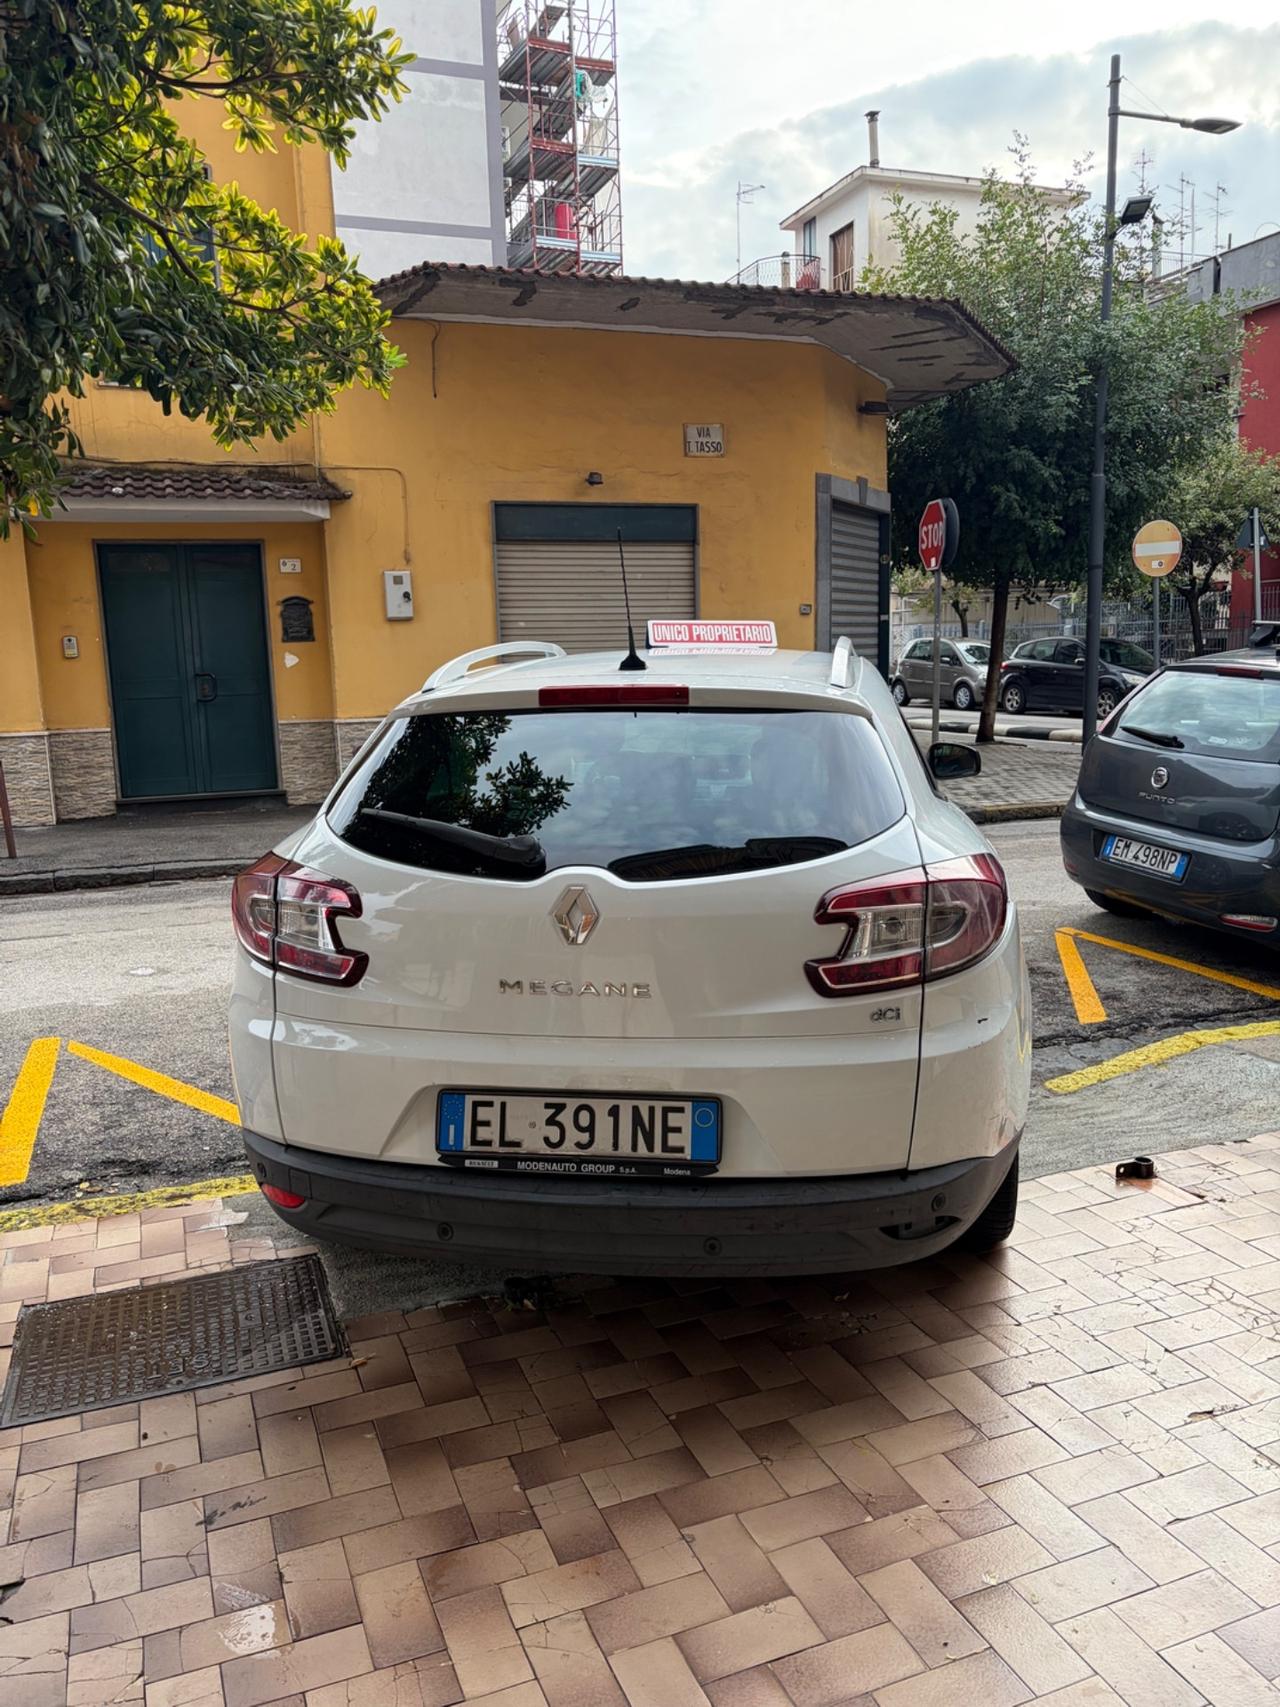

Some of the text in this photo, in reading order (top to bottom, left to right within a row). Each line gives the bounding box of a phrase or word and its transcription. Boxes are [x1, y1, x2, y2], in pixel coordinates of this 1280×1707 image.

[696, 426, 711, 438] VIA
[687, 441, 722, 453] T. TASSO
[921, 520, 944, 550] STOP
[653, 624, 771, 643] UNICO PROPRIETARIO
[1139, 791, 1175, 805] PUNTO
[1112, 839, 1132, 859] EM
[1132, 844, 1178, 871] 498NP
[499, 979, 652, 998] MEGANE
[470, 1100, 522, 1148] EL
[543, 1102, 686, 1153] 391NE
[517, 1161, 577, 1172] MODENAUTO
[581, 1163, 616, 1173] GROUP
[663, 1167, 691, 1176] Modena
